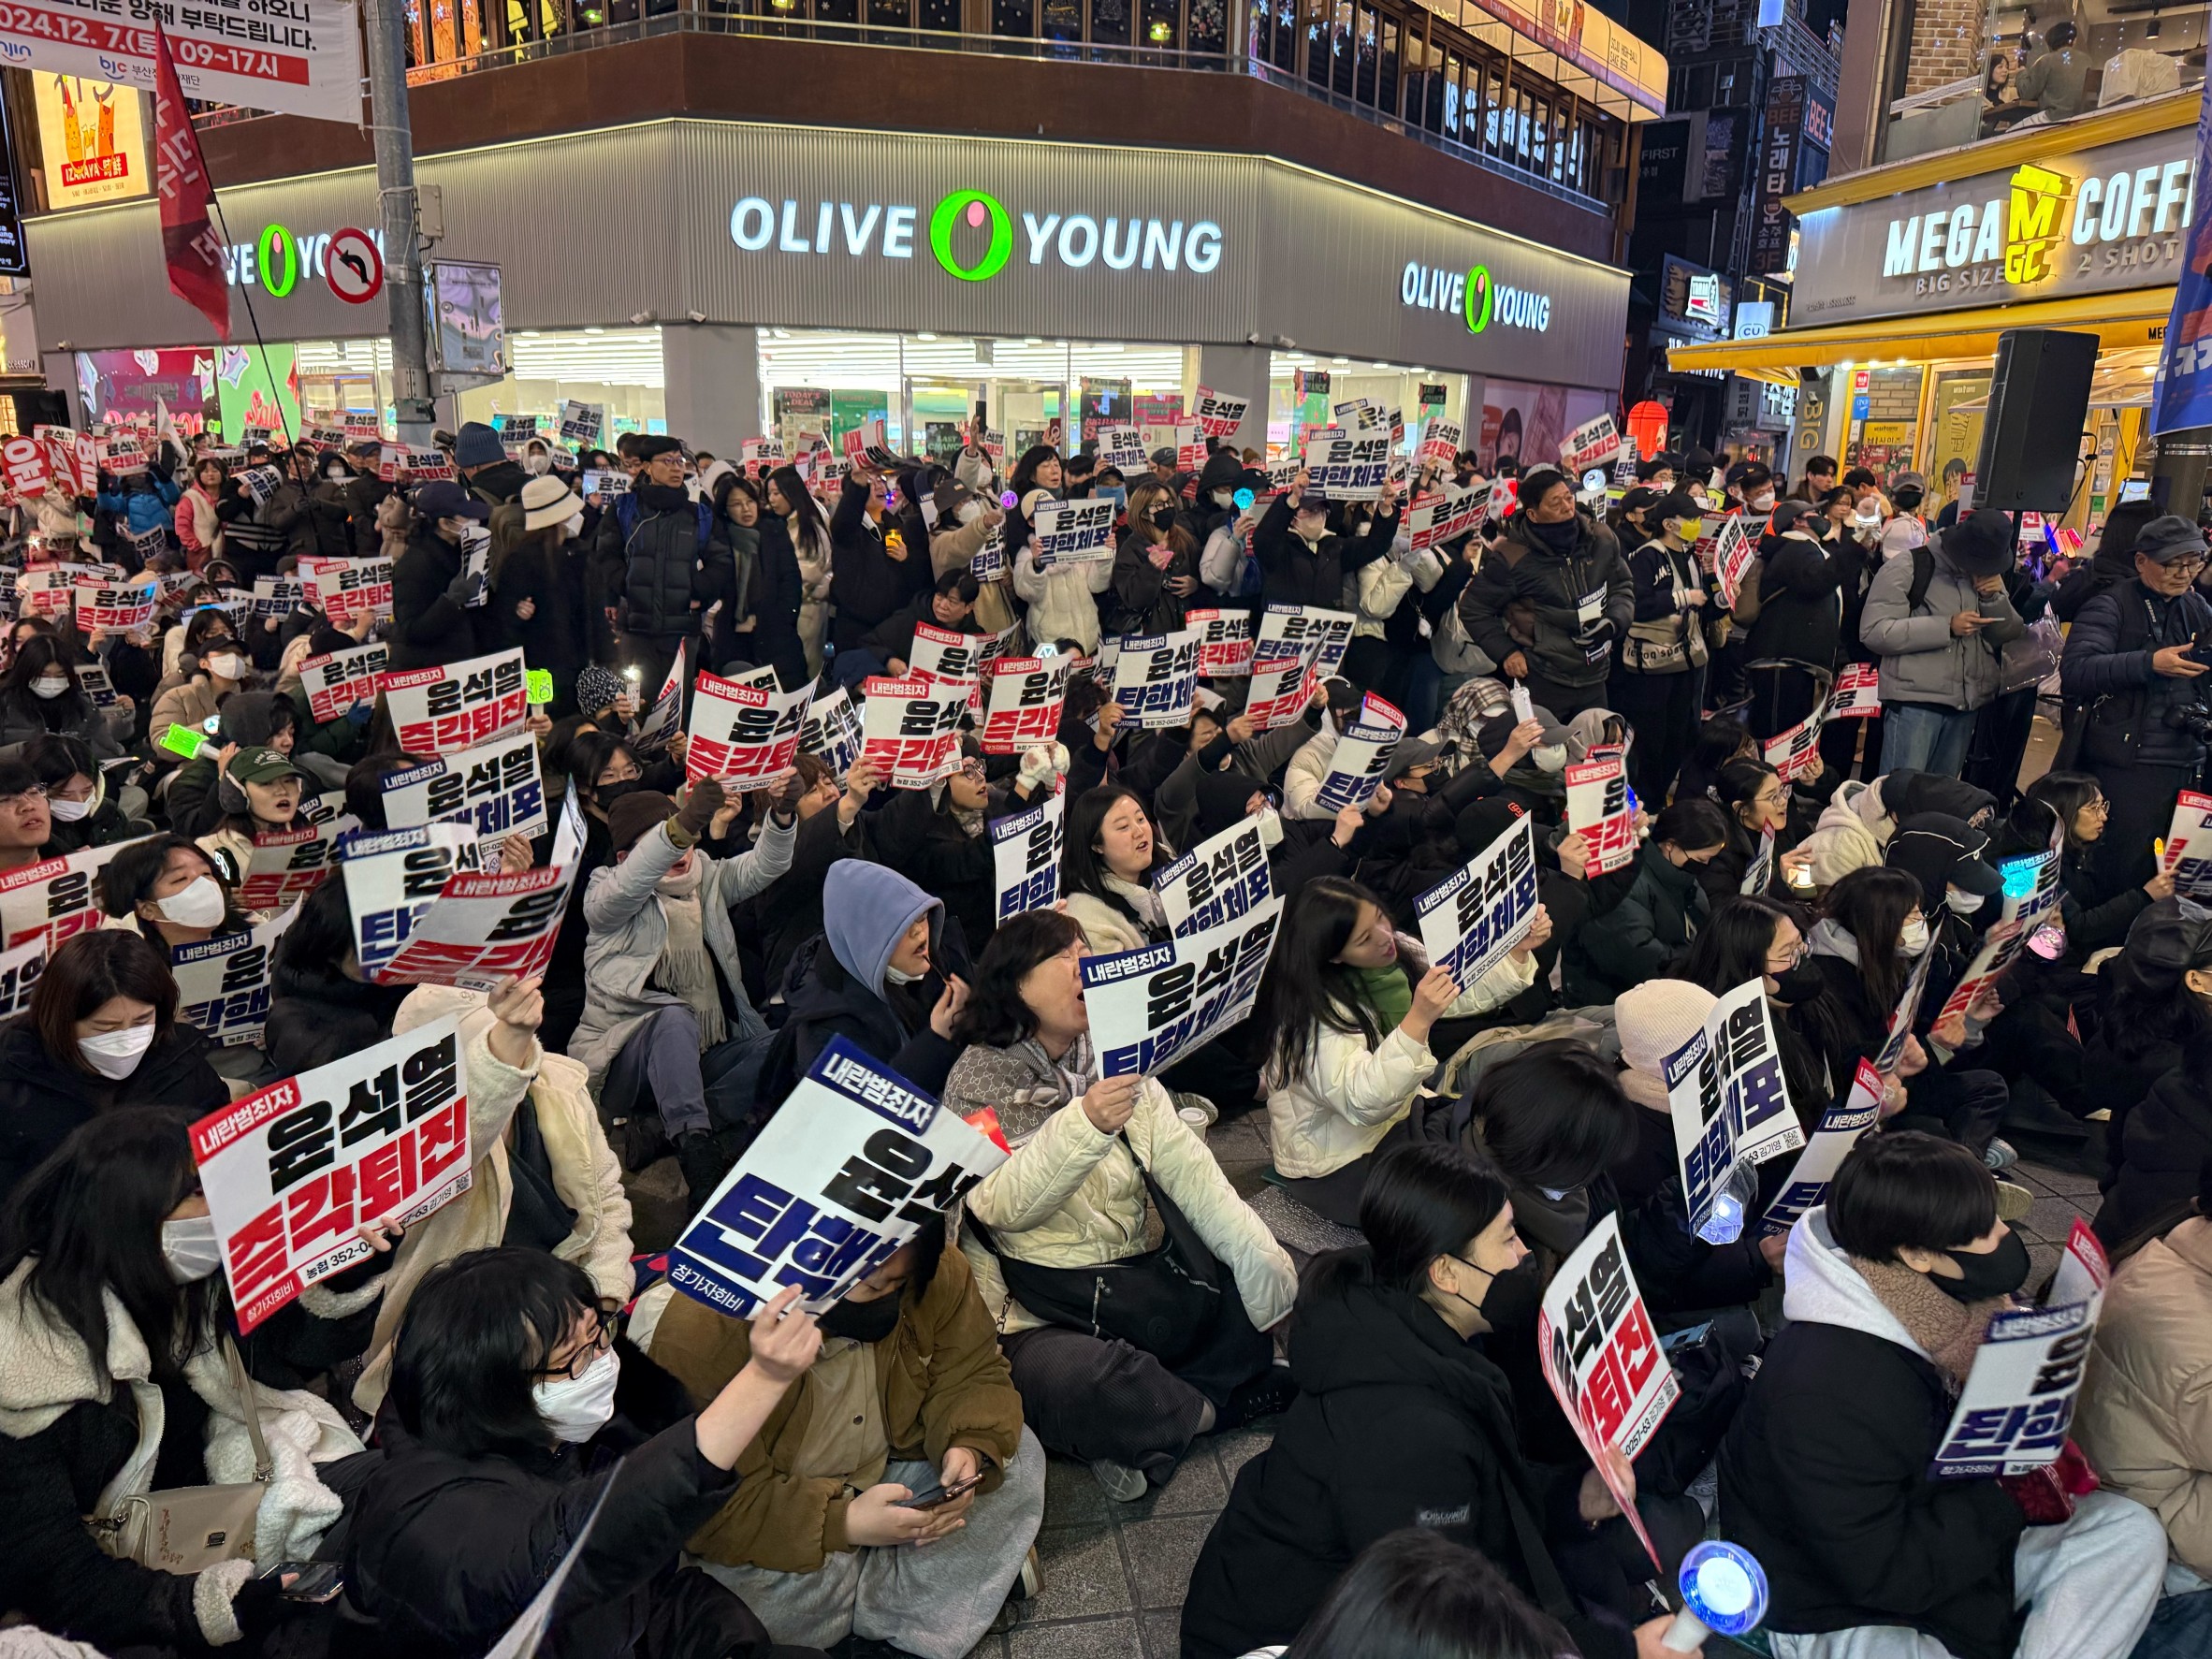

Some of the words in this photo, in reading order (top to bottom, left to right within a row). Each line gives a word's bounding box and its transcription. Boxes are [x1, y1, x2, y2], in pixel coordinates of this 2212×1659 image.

[181, 7, 316, 51] 부탁드립니다.
[179, 39, 278, 79] 09~17시
[1768, 107, 1799, 125] BEE
[1641, 147, 1679, 160] FIRST
[65, 165, 100, 182] IZAKAYA
[1883, 199, 2001, 278] MEGA
[2072, 158, 2192, 245] COFF
[731, 197, 917, 258] OLIVE
[1022, 211, 1223, 273] YOUNG
[1755, 251, 1780, 270] 3F
[2078, 253, 2091, 272] 2
[2104, 239, 2180, 269] SHOT
[1402, 261, 1464, 314] OLIVE
[1493, 284, 1550, 332] YOUNG
[1915, 274, 1951, 297] BIG
[1957, 266, 2005, 289] SIZE
[1743, 327, 1761, 336] CU
[791, 398, 814, 406] DEAL
[1200, 397, 1247, 420] 윤석열
[1111, 431, 1142, 450] 윤석열
[1799, 401, 1823, 450] BIG
[1327, 438, 1390, 464] 윤석열
[1309, 465, 1388, 489] 탄핵체포
[1036, 500, 1068, 511] 내란범죄자
[1055, 502, 1113, 532] 윤석열
[1431, 485, 1492, 526] 윤석열
[1412, 503, 1489, 549] 즉각퇴진
[1041, 526, 1114, 557] 탄핵체포
[315, 561, 348, 575] 내란범죄자
[339, 561, 393, 590] 윤석열
[971, 552, 1007, 577] 탄핵
[32, 589, 73, 607] 즉각
[95, 587, 155, 607] 윤석열
[326, 583, 393, 613] 즉각퇴진
[1268, 604, 1302, 615] 내란범죄자
[78, 604, 153, 627] 즉각퇴진
[1282, 616, 1353, 643] 윤석열
[918, 626, 963, 645] 내란범죄자
[1124, 635, 1165, 651] 내란범죄자
[298, 655, 330, 672] 내란범죄자
[323, 648, 387, 686] 윤석열
[998, 660, 1041, 675] 내란범죄자
[1257, 658, 1298, 674] 내란범죄자
[1643, 649, 1657, 660] oq
[388, 669, 443, 690] 내란범죄자
[427, 657, 521, 717] 윤석열
[703, 678, 765, 706] 내란범죄자
[870, 681, 926, 698] 내란범죄자
[1114, 674, 1199, 717] 탄핵체
[400, 689, 527, 752] 즉각퇴진
[728, 696, 810, 744] 윤석
[898, 697, 967, 736] 윤석
[1145, 719, 1155, 727] 농협
[1348, 726, 1399, 742] 내란범죄자
[687, 733, 800, 777] 즉각퇴
[385, 761, 444, 790] 내란범죄자
[427, 742, 534, 819] 윤석열
[895, 778, 910, 787] 농협
[1570, 761, 1620, 783] 내란범죄자
[996, 808, 1042, 839] 내란범죄자
[1, 859, 65, 889] 내란범죄자
[453, 868, 554, 895] 내란범죄자
[1157, 853, 1195, 888] 내란범죄자
[1186, 825, 1263, 910] 윤석열
[1456, 822, 1531, 938] 윤석열
[998, 861, 1061, 923] 탄핵
[1173, 861, 1270, 939] 탄핵체포
[1418, 868, 1468, 913] 내란범죄자
[1434, 863, 1537, 985] 탄핵체포
[179, 935, 249, 962] 내란범죄자
[1086, 945, 1171, 982] 내란범죄자
[1147, 910, 1280, 1032] 윤석열
[1465, 971, 1477, 984] 농협
[182, 987, 270, 1036] 탄핵
[1101, 967, 1262, 1077] 탄핵체포
[1667, 1034, 1707, 1084] 내란범죄자
[1698, 995, 1768, 1128] 윤석열
[821, 1053, 935, 1129] 내란범죄자
[198, 1084, 294, 1156] 내란범죄자
[267, 1032, 458, 1197] 윤석열
[1825, 1109, 1877, 1128] 내란범죄자
[1683, 1055, 1785, 1221] 탄핵체포
[1759, 1140, 1782, 1158] 김기영
[820, 1128, 984, 1224] 윤석
[227, 1095, 468, 1304] 즉각퇴진
[246, 1280, 294, 1322] 참가자회비
[306, 1260, 328, 1280] 농협
[429, 1186, 452, 1211] 김기영
[670, 1262, 745, 1312] 참가자회비
